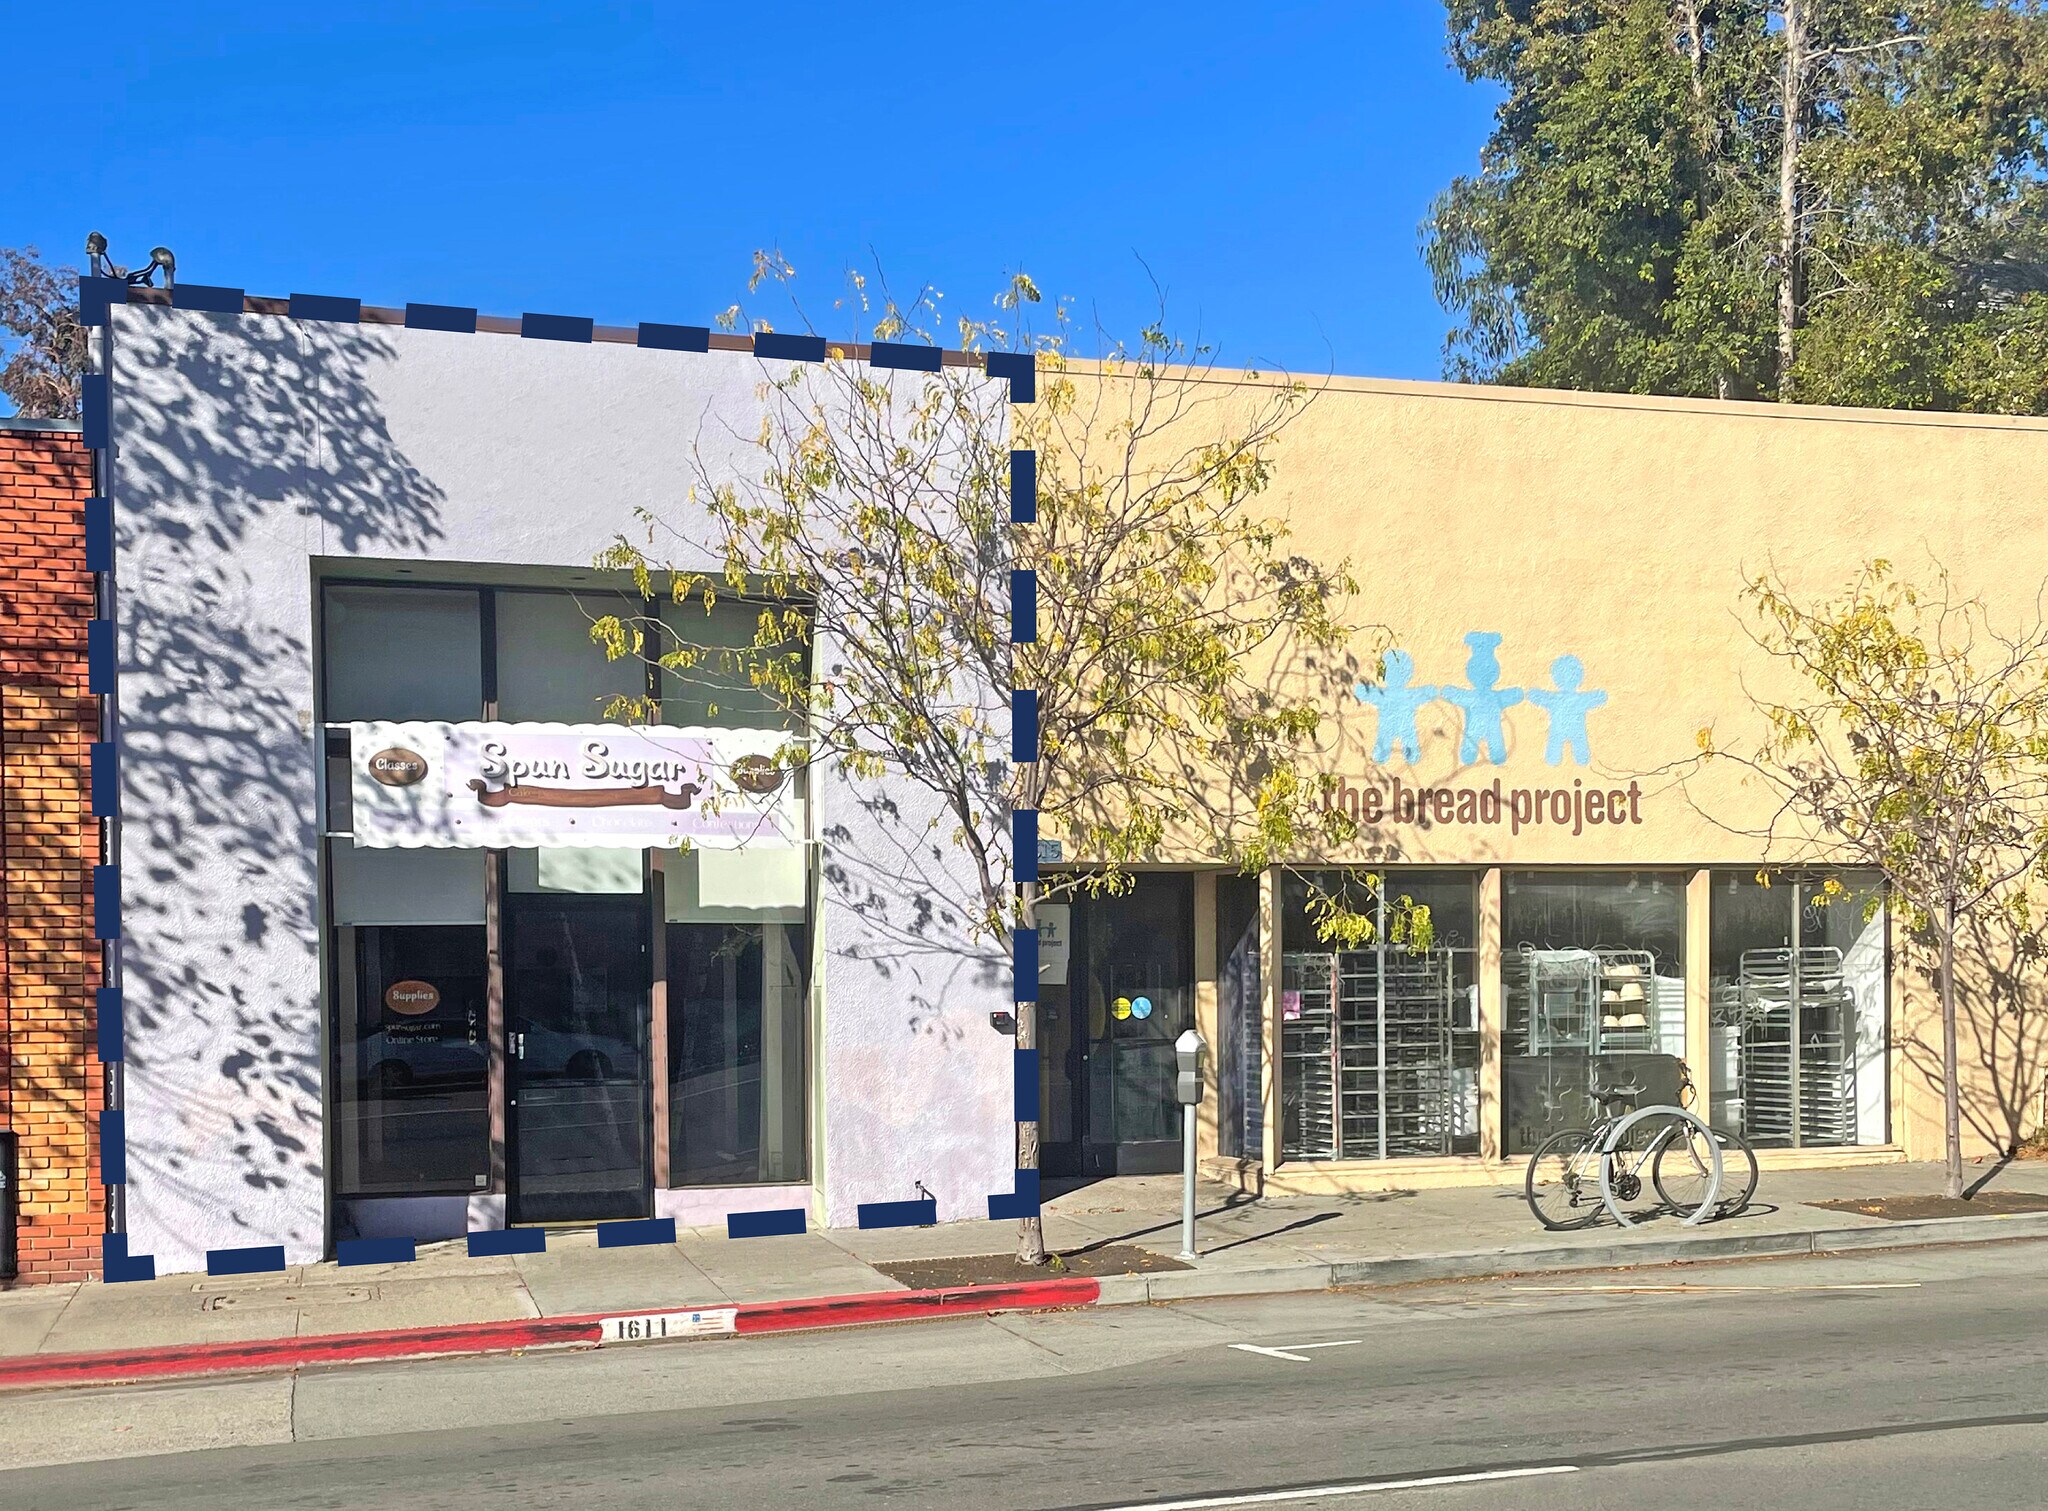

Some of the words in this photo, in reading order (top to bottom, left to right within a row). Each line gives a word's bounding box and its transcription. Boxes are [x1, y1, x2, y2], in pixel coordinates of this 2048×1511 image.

[375, 757, 418, 771] Classes
[480, 741, 571, 788] Spun
[581, 741, 687, 790] Sugar
[1392, 776, 1501, 825] bread
[1511, 778, 1643, 836] project
[392, 989, 434, 1003] Supplies
[618, 1317, 666, 1340] 1611
